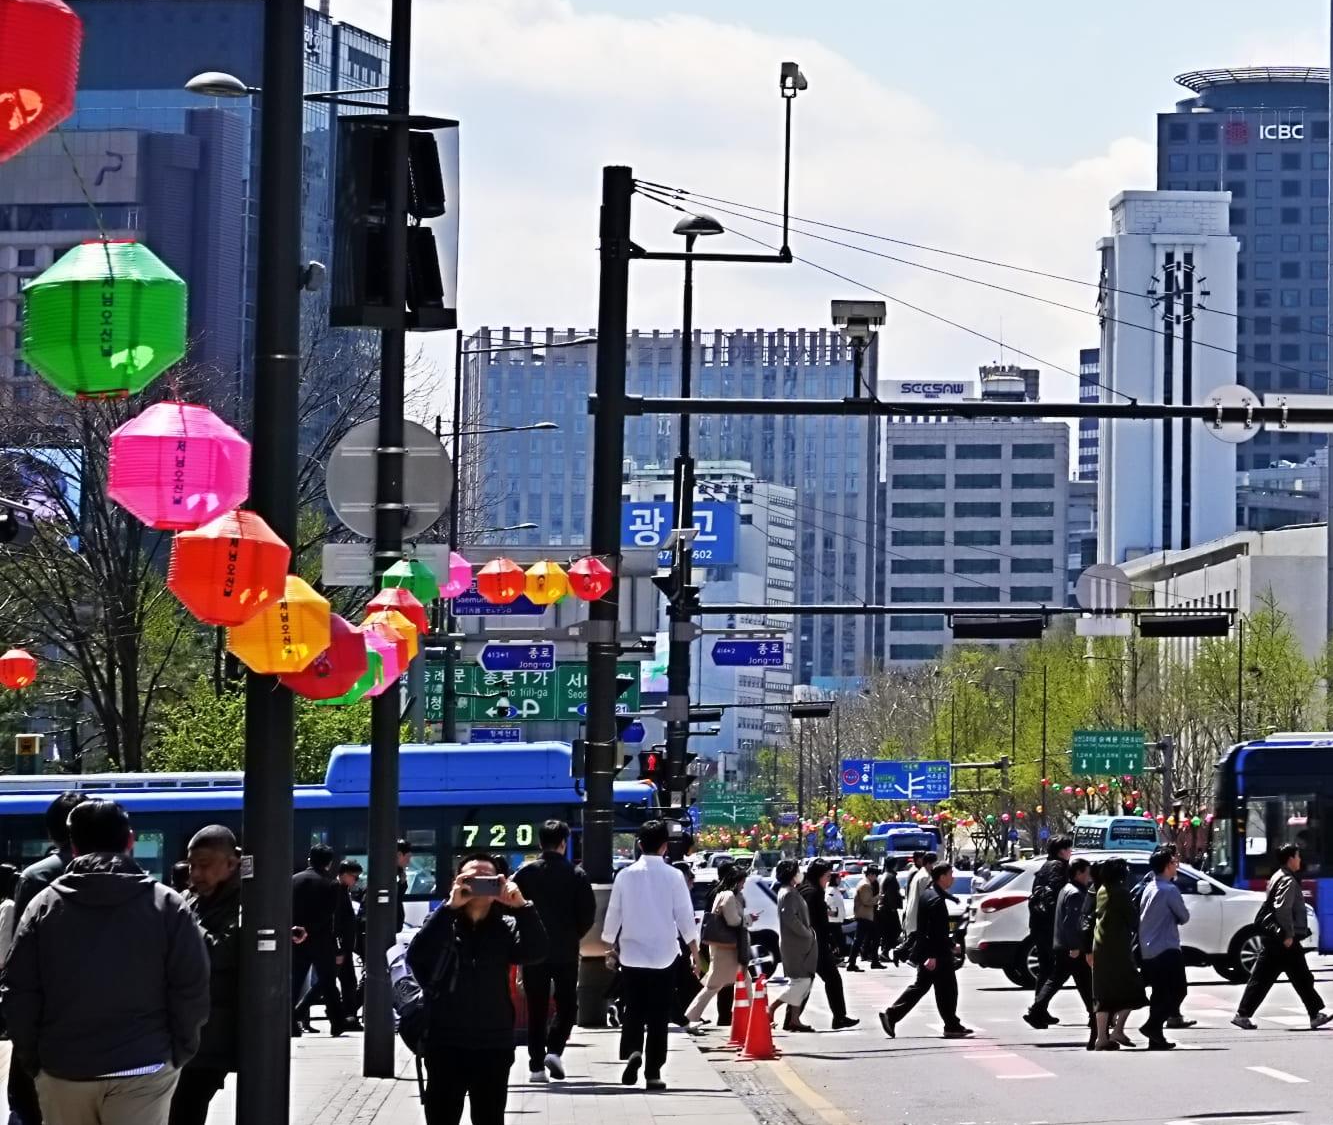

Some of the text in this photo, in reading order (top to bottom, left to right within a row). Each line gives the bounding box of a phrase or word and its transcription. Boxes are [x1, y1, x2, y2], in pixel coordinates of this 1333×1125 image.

[1260, 124, 1304, 140] ICBC
[528, 648, 551, 658] 종로
[757, 642, 781, 655] 종로
[519, 661, 551, 670] Jong-ro
[749, 656, 781, 666] Jong-ro
[463, 824, 533, 847] 720
